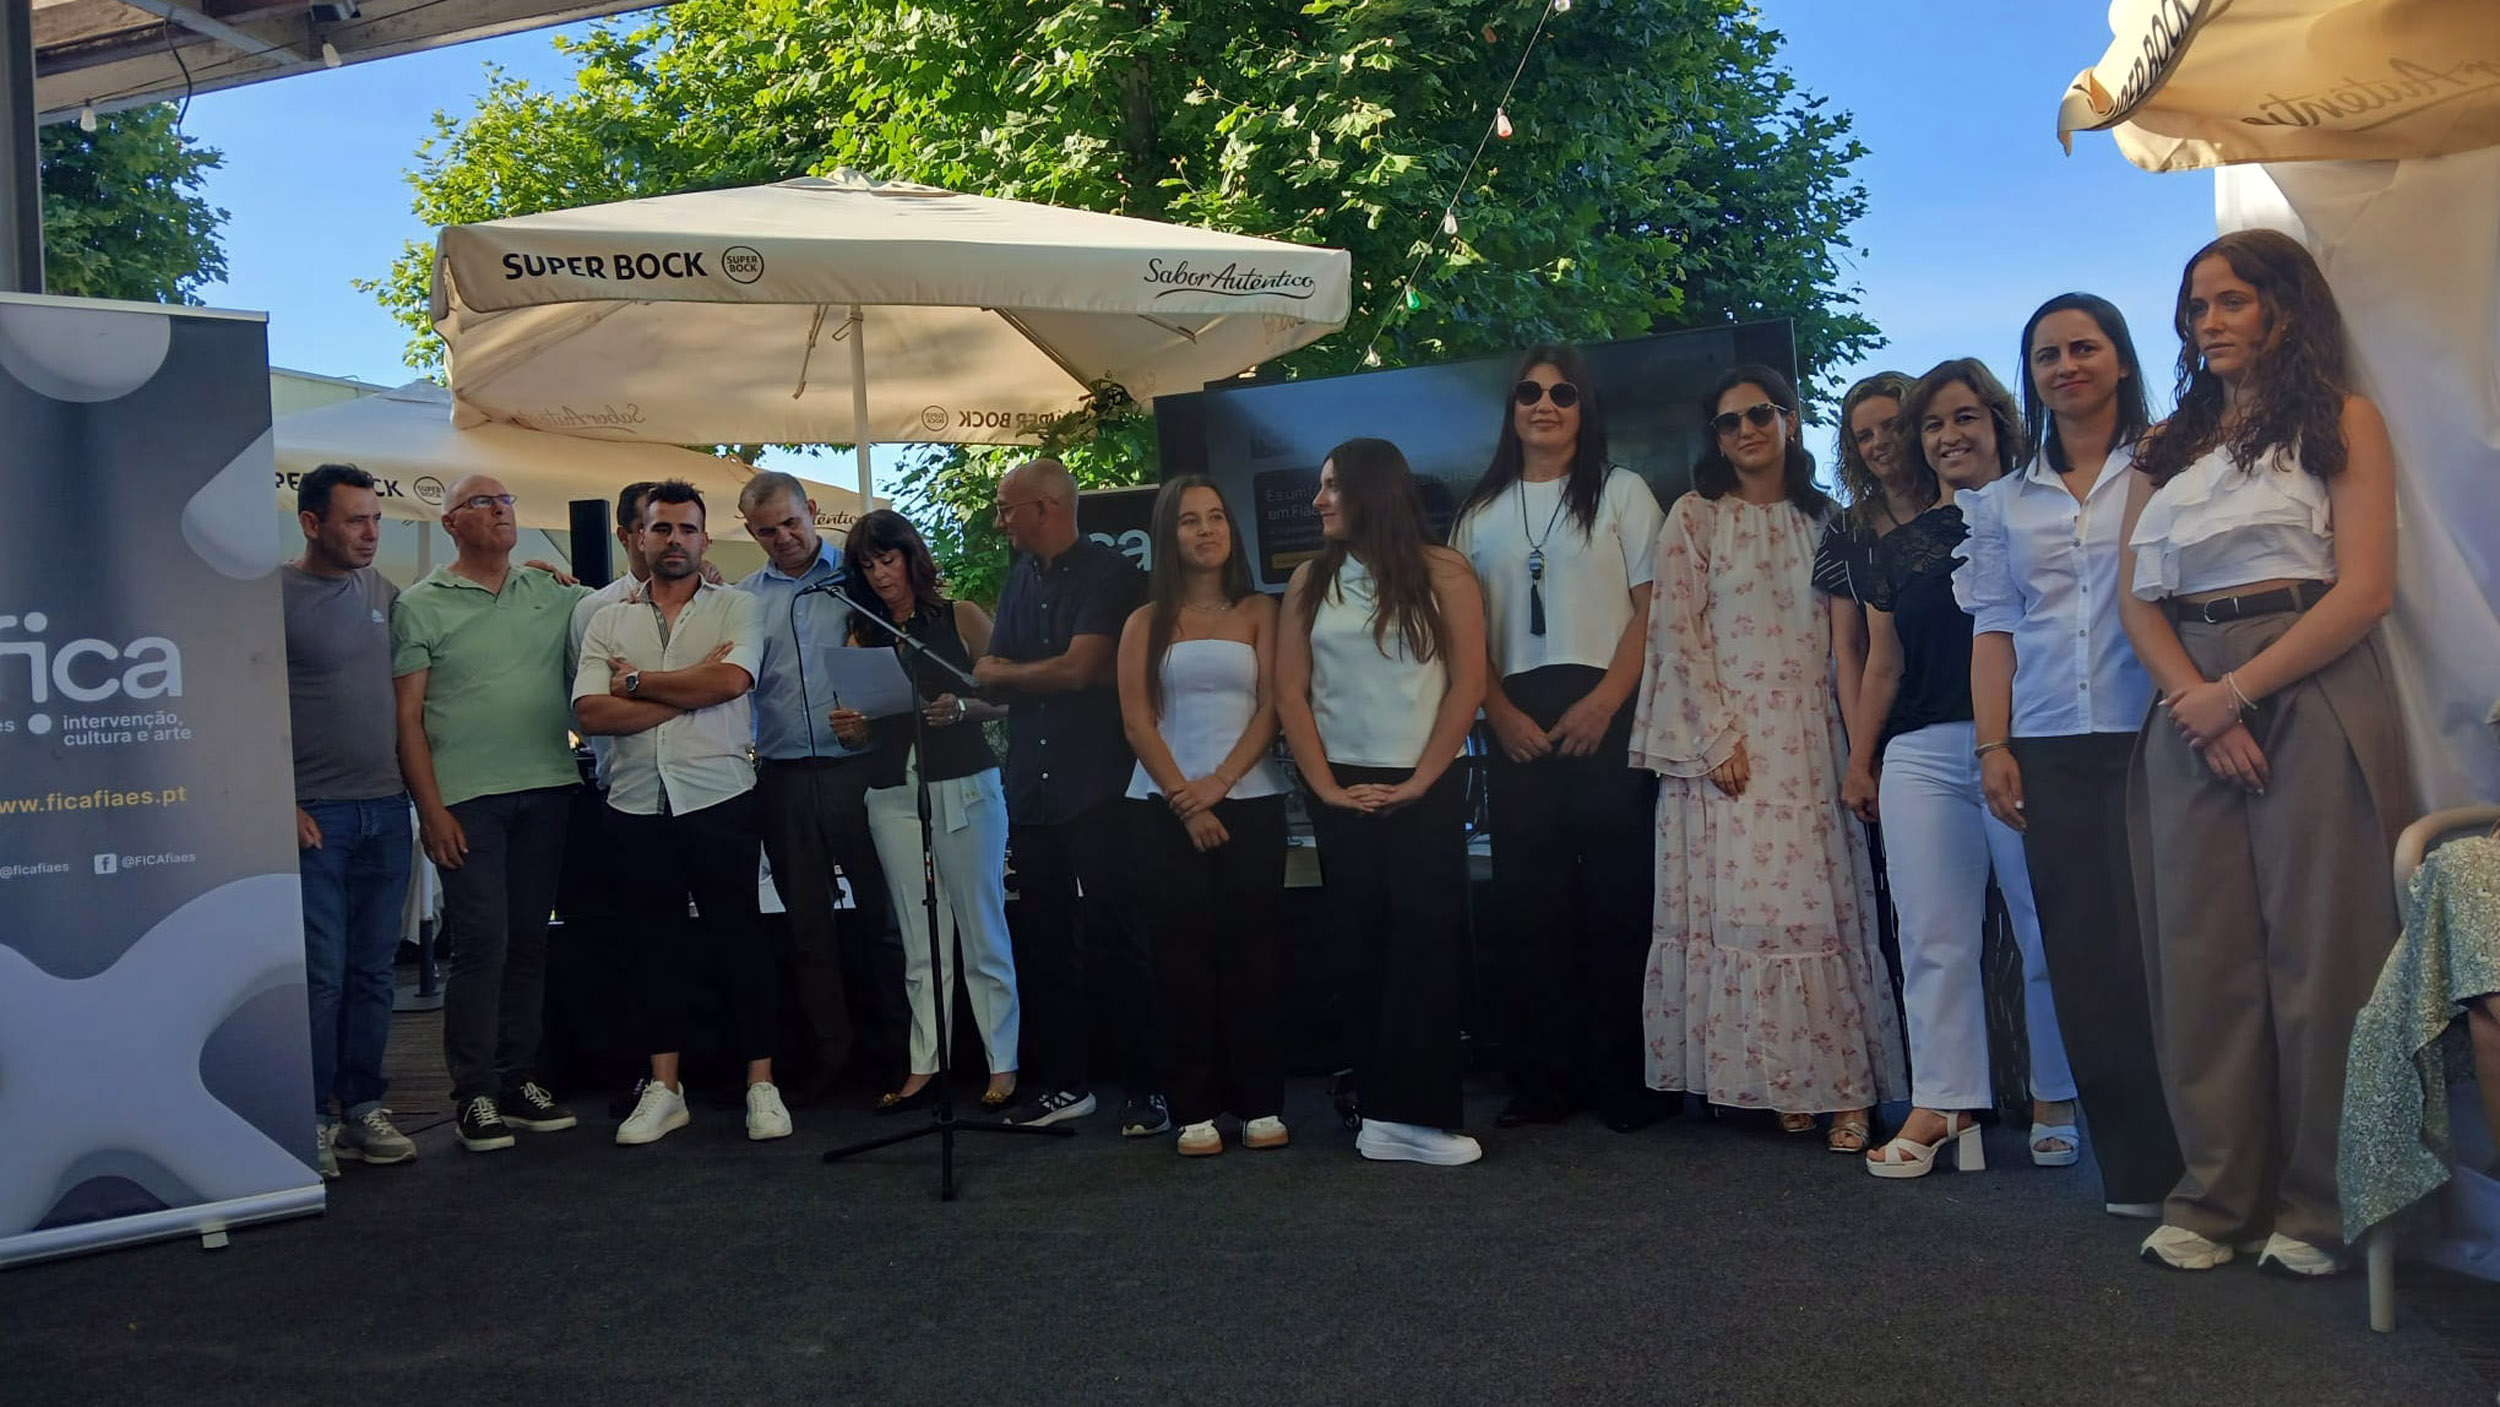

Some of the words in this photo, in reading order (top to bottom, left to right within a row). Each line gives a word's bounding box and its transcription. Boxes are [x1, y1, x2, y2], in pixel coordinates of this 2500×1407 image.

[502, 253, 607, 280] SUPER
[613, 251, 709, 281] BOCK
[726, 255, 757, 264] SUPER
[729, 264, 757, 272] BOCK
[1143, 257, 1210, 287] Sabor
[1210, 262, 1316, 291] Autêntico
[63, 710, 183, 731] intervenção,
[63, 731, 132, 746] cultura
[137, 732, 149, 742] e
[154, 727, 193, 742] arte
[121, 852, 197, 869] @FICAfiaes
